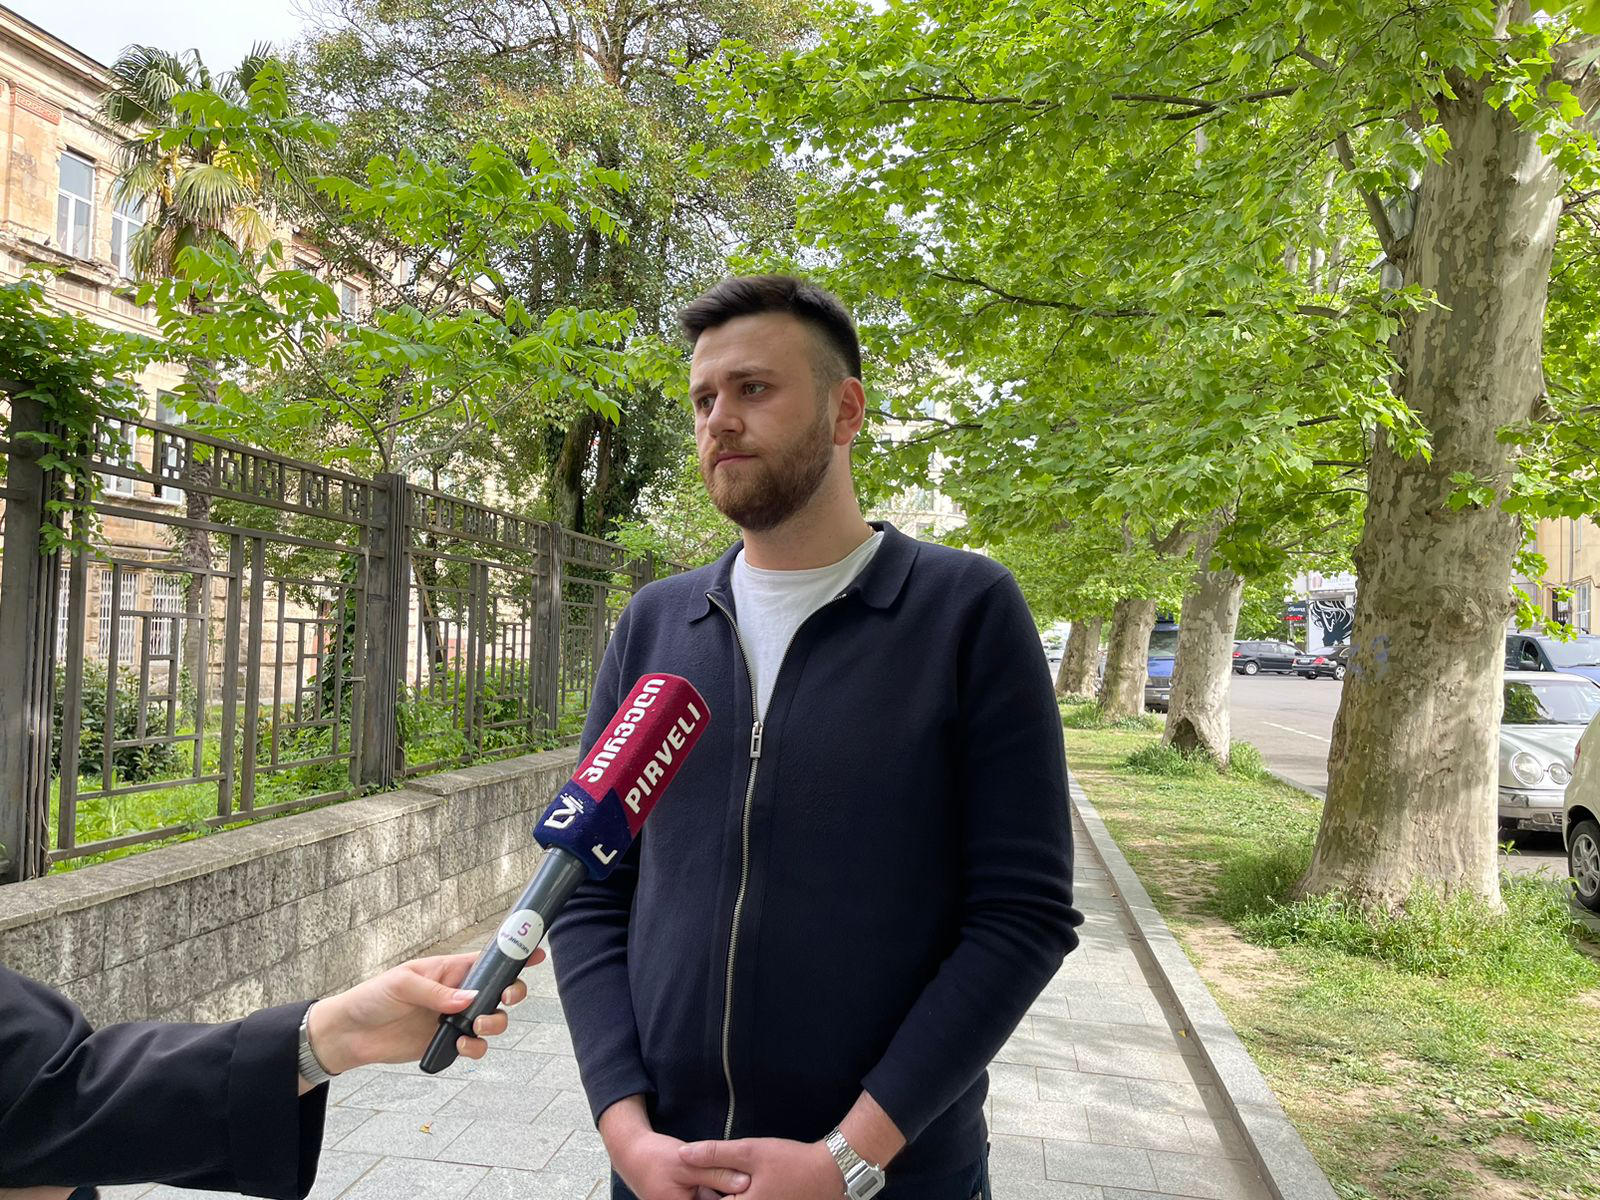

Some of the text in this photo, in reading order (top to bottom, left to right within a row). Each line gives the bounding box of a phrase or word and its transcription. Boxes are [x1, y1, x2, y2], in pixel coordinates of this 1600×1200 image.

[578, 678, 666, 783] პირველი
[624, 702, 701, 814] PIRVELI
[517, 921, 532, 937] 5
